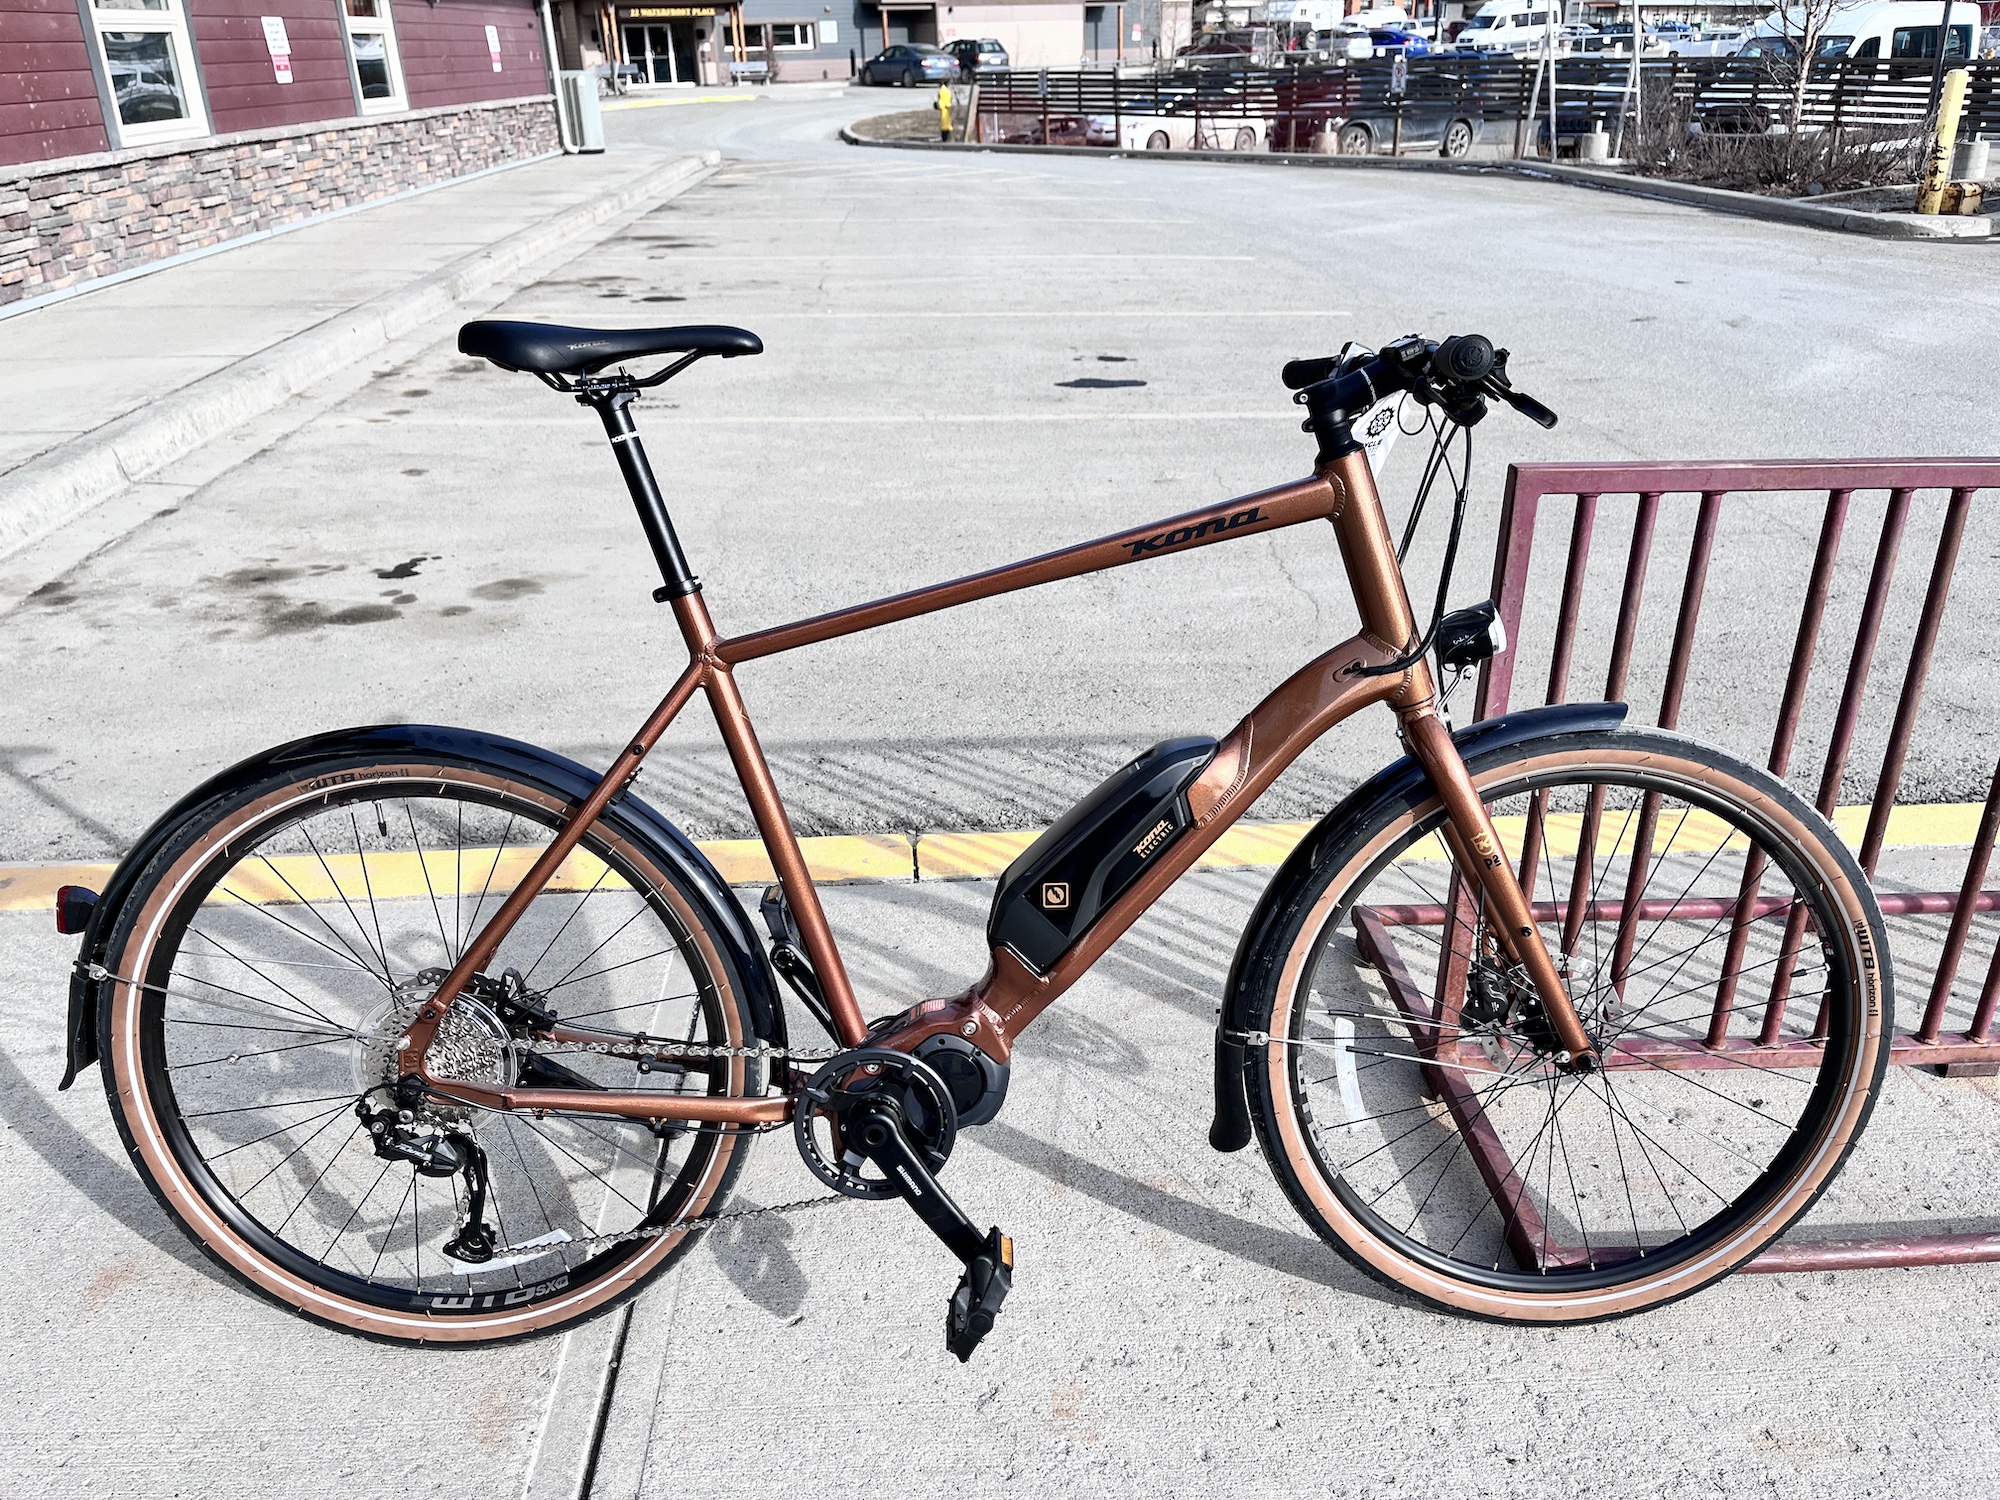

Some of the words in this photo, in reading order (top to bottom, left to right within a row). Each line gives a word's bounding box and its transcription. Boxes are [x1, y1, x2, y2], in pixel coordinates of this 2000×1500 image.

[641, 8, 691, 17] WATERFRONT
[692, 7, 716, 16] PLACE
[358, 770, 399, 780] horizon
[1140, 823, 1174, 858] ELECTRIC
[1866, 972, 1877, 1008] horizon
[896, 1164, 922, 1198] SHIMANO
